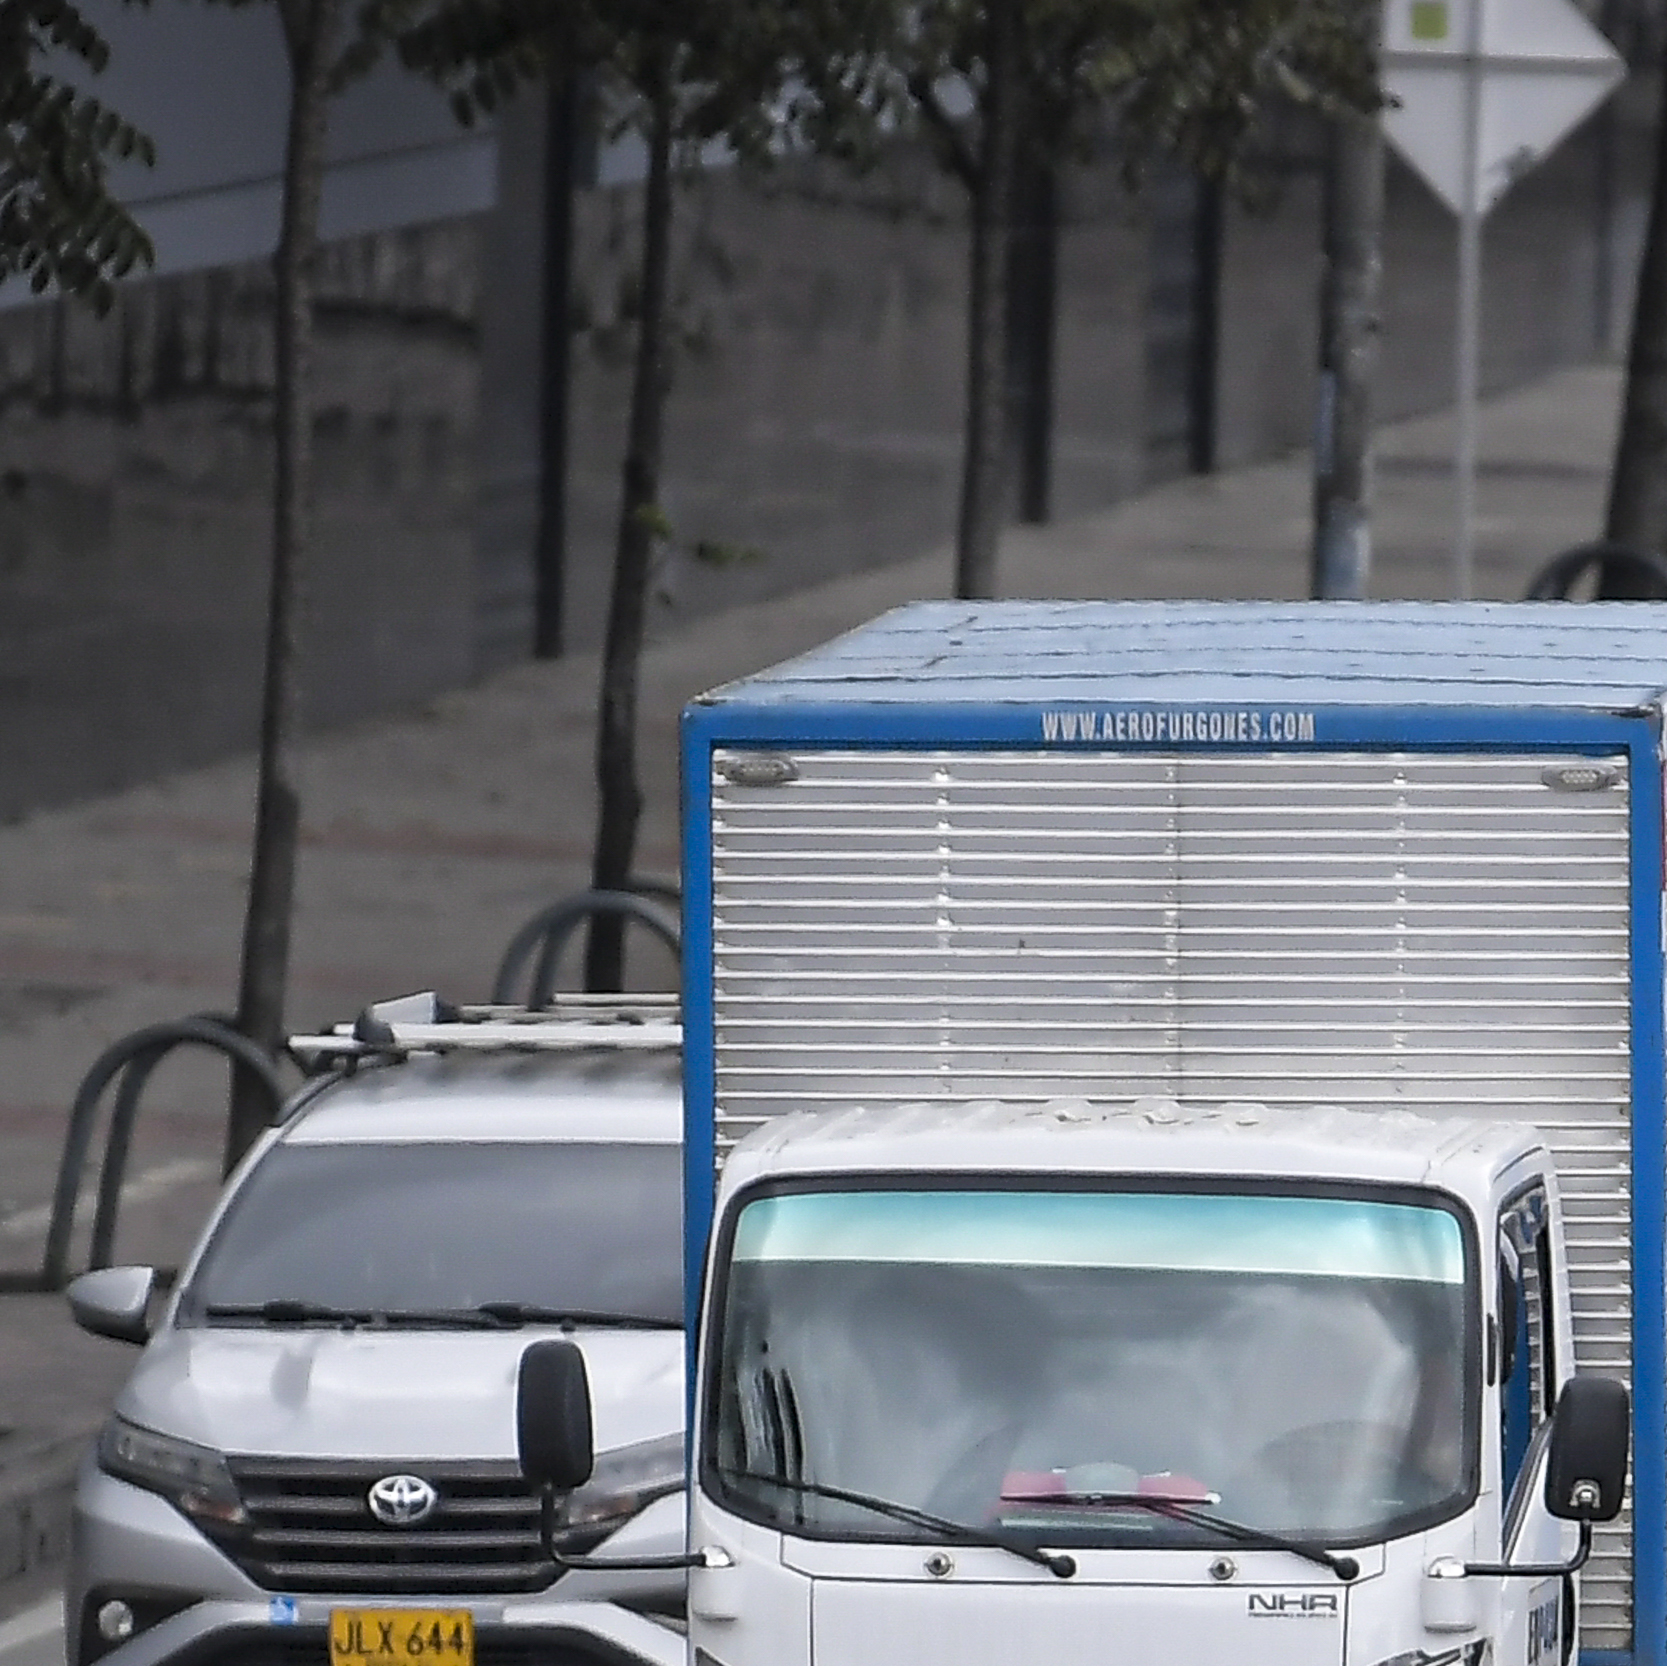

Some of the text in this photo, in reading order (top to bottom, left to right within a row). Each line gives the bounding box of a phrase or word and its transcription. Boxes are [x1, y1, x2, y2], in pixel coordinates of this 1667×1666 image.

[1041, 711, 1315, 741] WWW.AEROFURGONES.COM
[1248, 1593, 1338, 1611] NHR
[334, 1620, 464, 1657] JLX 644
